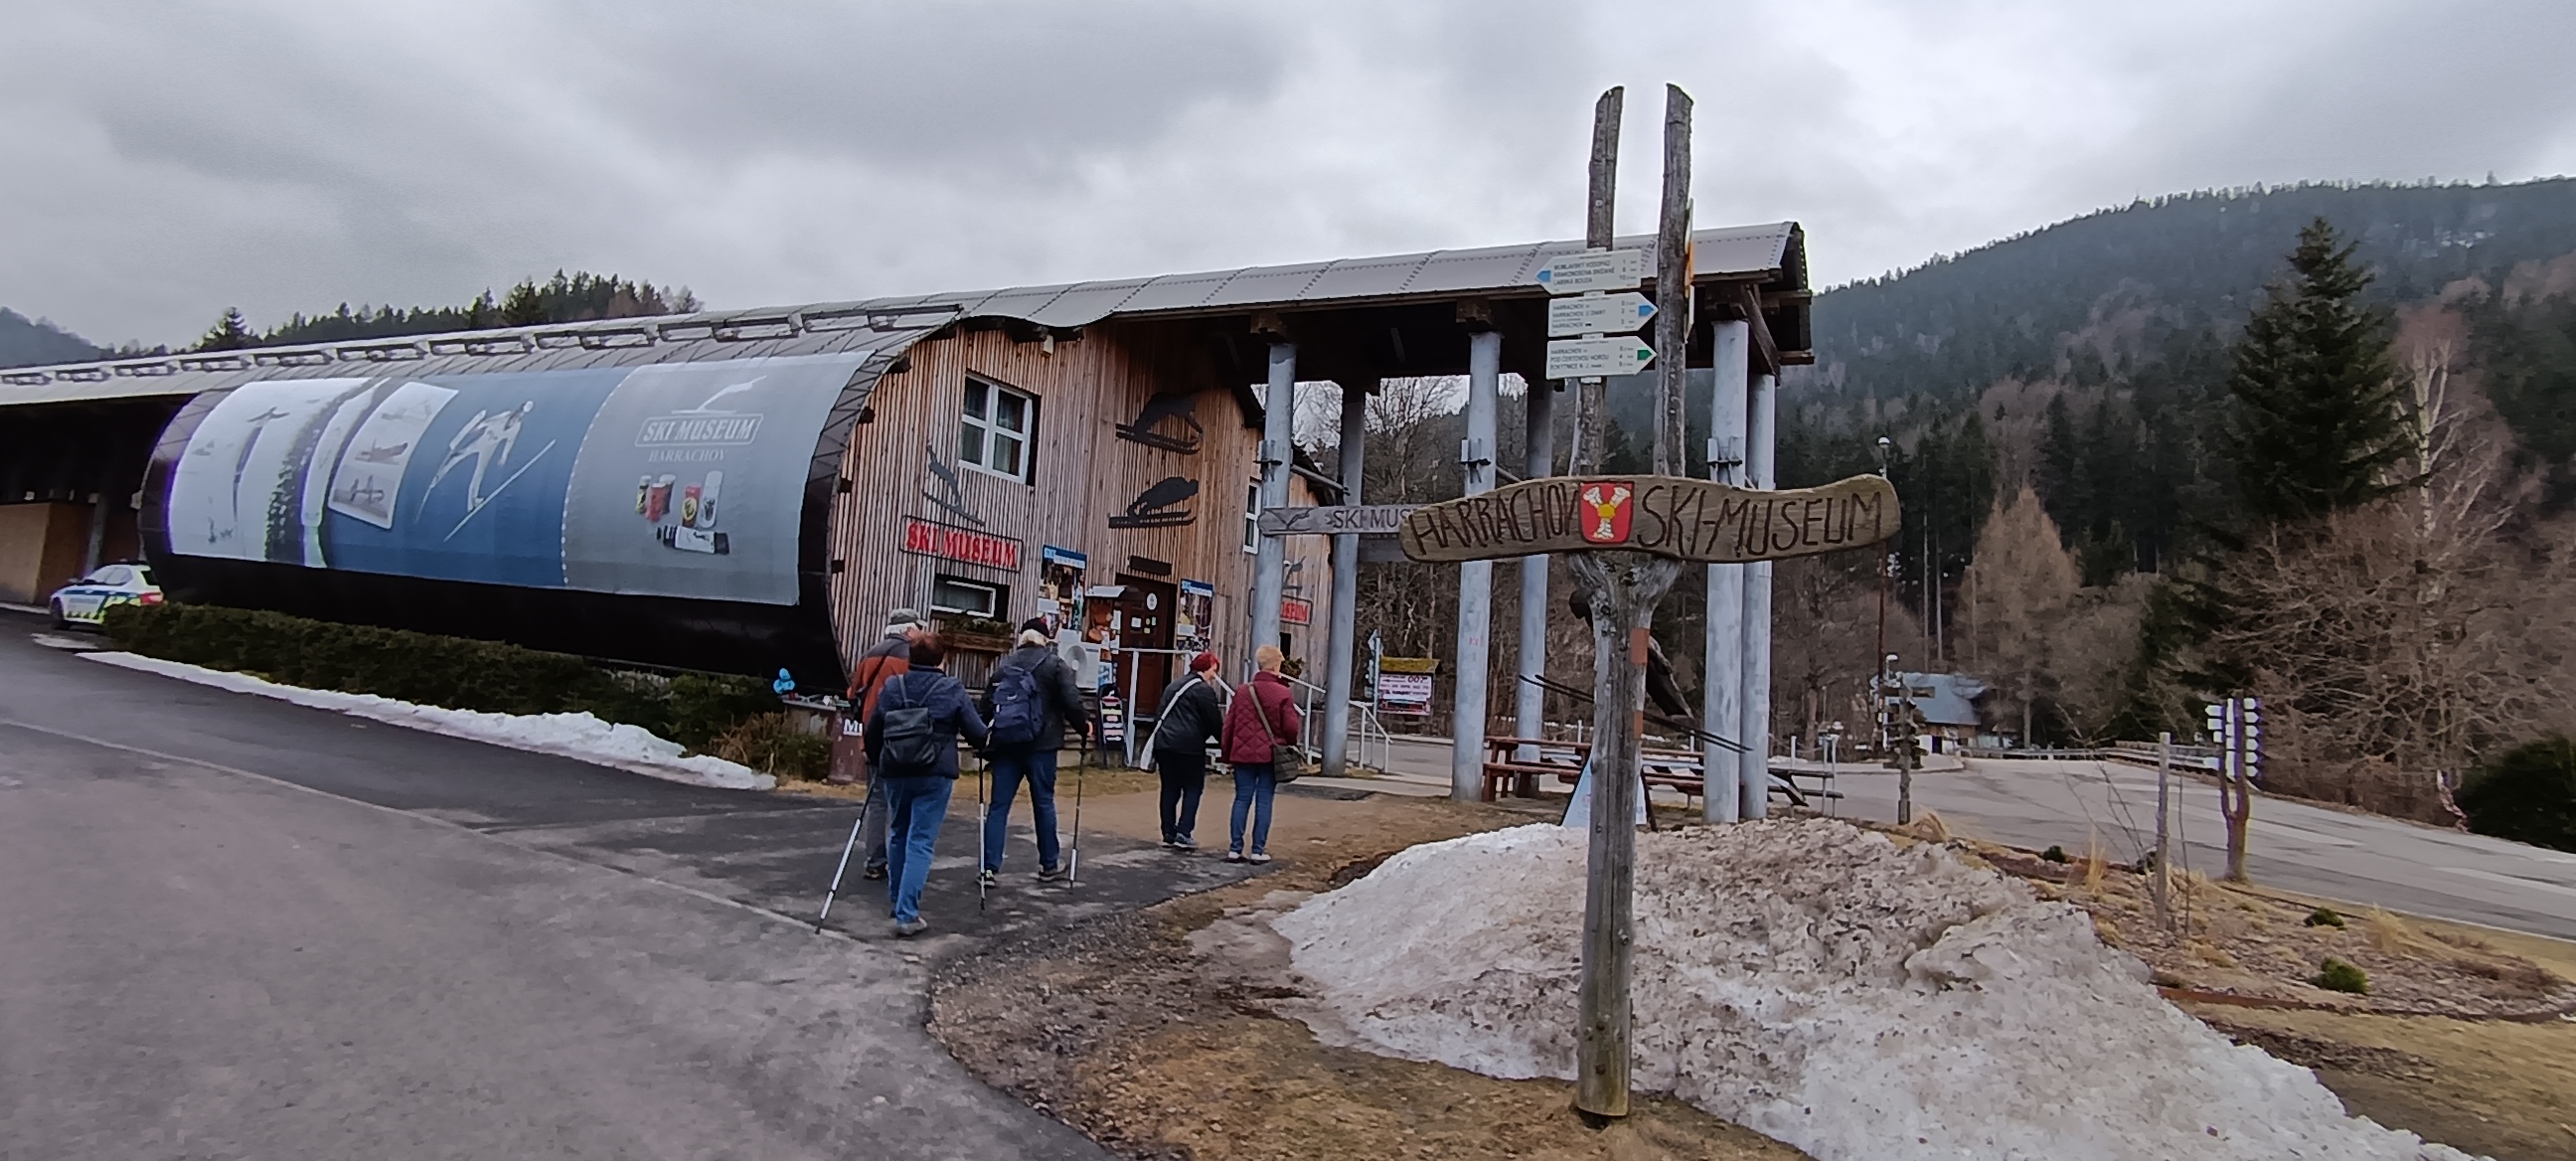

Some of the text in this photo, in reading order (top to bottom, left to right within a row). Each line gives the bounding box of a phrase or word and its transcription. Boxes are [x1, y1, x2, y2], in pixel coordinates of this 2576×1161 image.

[643, 418, 756, 442] SKI MUSEUM
[648, 449, 728, 463] HARRACHOV
[1333, 509, 1412, 529] SKI-MUS
[1409, 483, 1881, 558] HARRACHOV SKI-MUSEUM
[906, 522, 938, 553] SKI
[942, 529, 1017, 568] MUSEUM
